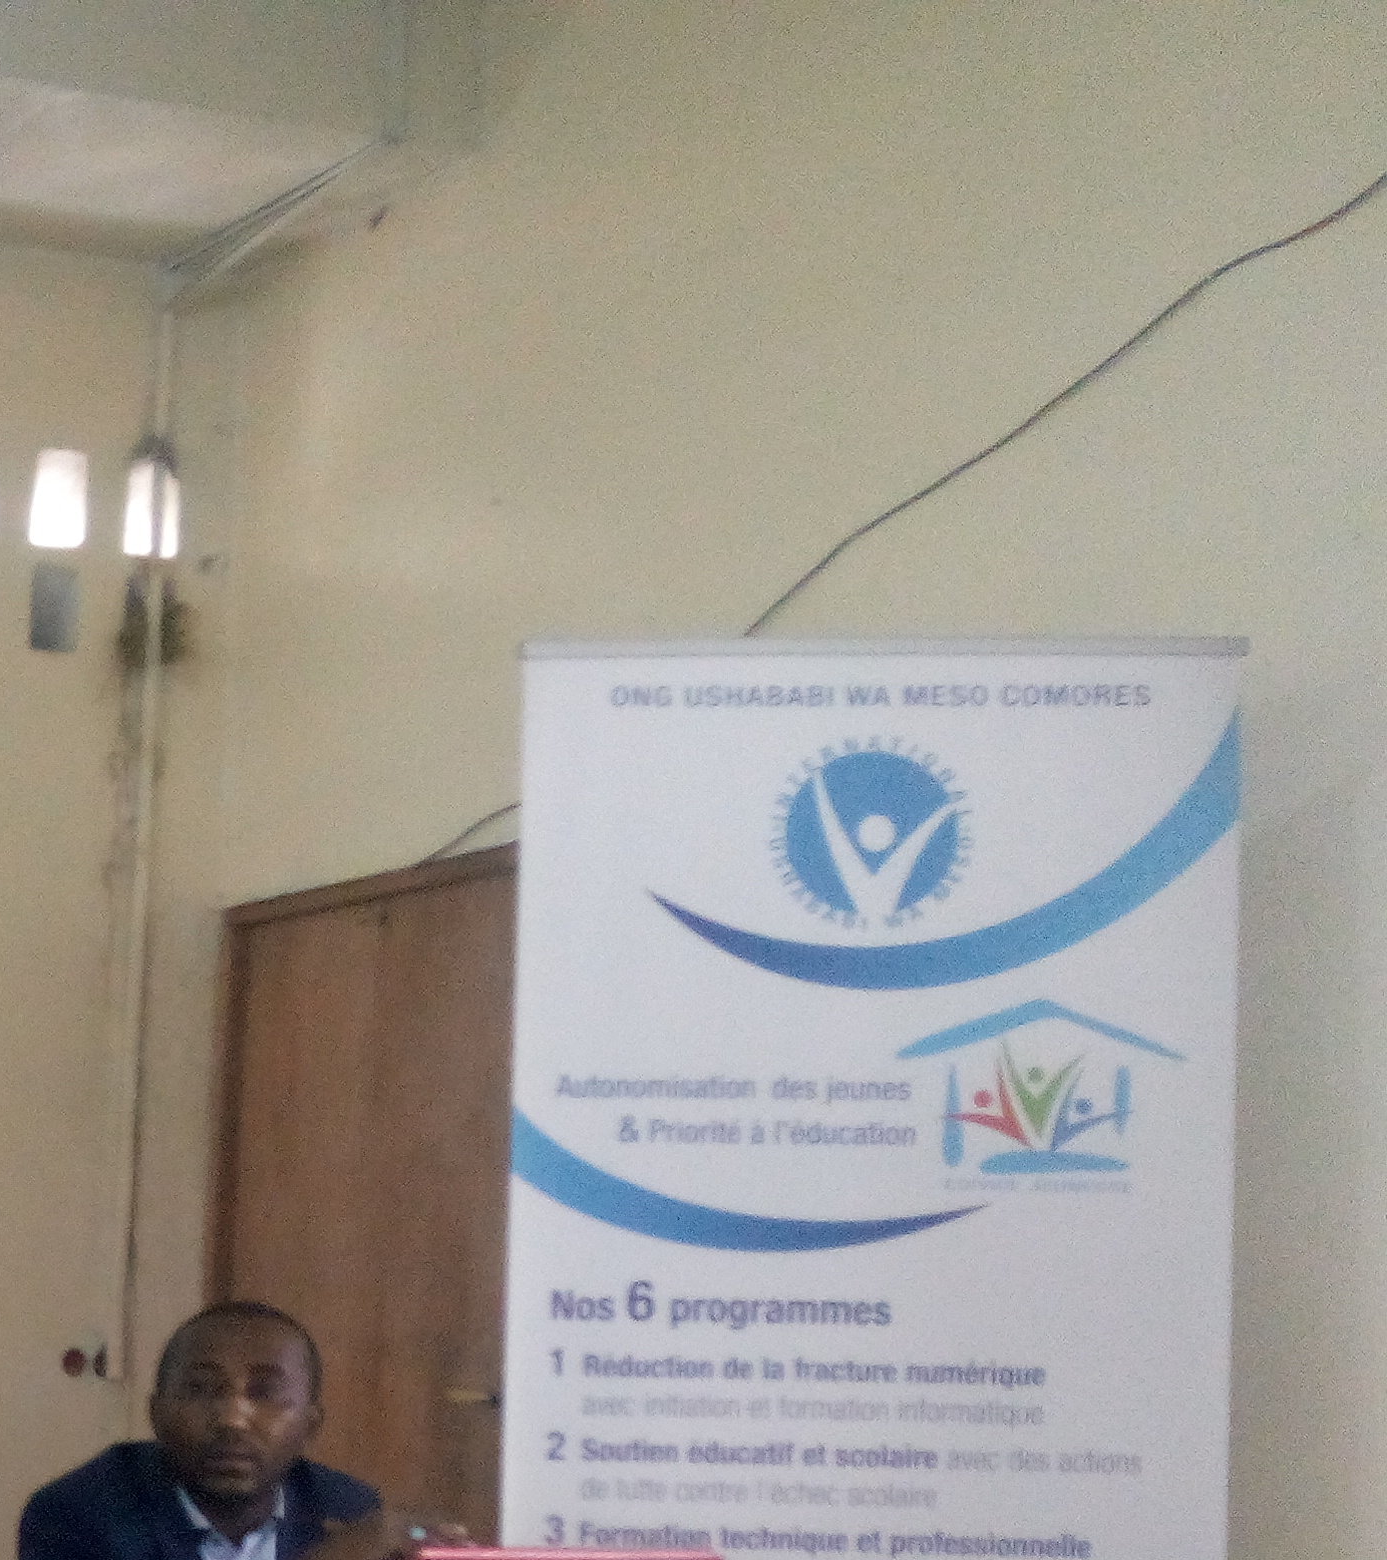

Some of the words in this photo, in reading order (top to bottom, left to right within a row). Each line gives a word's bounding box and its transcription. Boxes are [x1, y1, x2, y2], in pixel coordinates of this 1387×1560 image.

[610, 683, 673, 708] ONG
[684, 683, 836, 708] USHABABI
[847, 684, 891, 707] WA
[903, 684, 990, 708] MESO
[1000, 683, 1153, 708] COMORES
[556, 1075, 757, 1099] Autonomisation
[771, 1076, 819, 1101] des
[825, 1076, 911, 1104] jeunes
[618, 1115, 640, 1142] &
[648, 1117, 741, 1144] Priorité
[750, 1119, 772, 1145] à
[775, 1118, 917, 1147] l'éducation
[551, 1290, 616, 1322] Nos
[627, 1280, 655, 1322] 6
[670, 1299, 892, 1330] programmes
[552, 1349, 565, 1377] 1
[583, 1353, 714, 1380] Réduction
[722, 1355, 753, 1380] de
[764, 1356, 785, 1381] la
[795, 1357, 898, 1383] fracture
[907, 1360, 1047, 1390] numérique
[582, 1397, 632, 1417] avec
[747, 1397, 772, 1419] et
[780, 1397, 889, 1421] formation
[899, 1400, 1045, 1429] informatique
[547, 1432, 566, 1462] 2
[582, 1437, 679, 1463] Soutien
[689, 1439, 794, 1465] éducatif
[803, 1442, 826, 1466] et
[836, 1443, 939, 1469] scolaire
[947, 1449, 1001, 1472] avec
[1008, 1447, 1051, 1472] des
[1059, 1447, 1144, 1474] actions
[546, 1515, 565, 1546] 3
[580, 1521, 711, 1549] Formation
[721, 1525, 849, 1554] technique
[858, 1531, 882, 1554] et
[889, 1531, 1092, 1559] professionnelle
